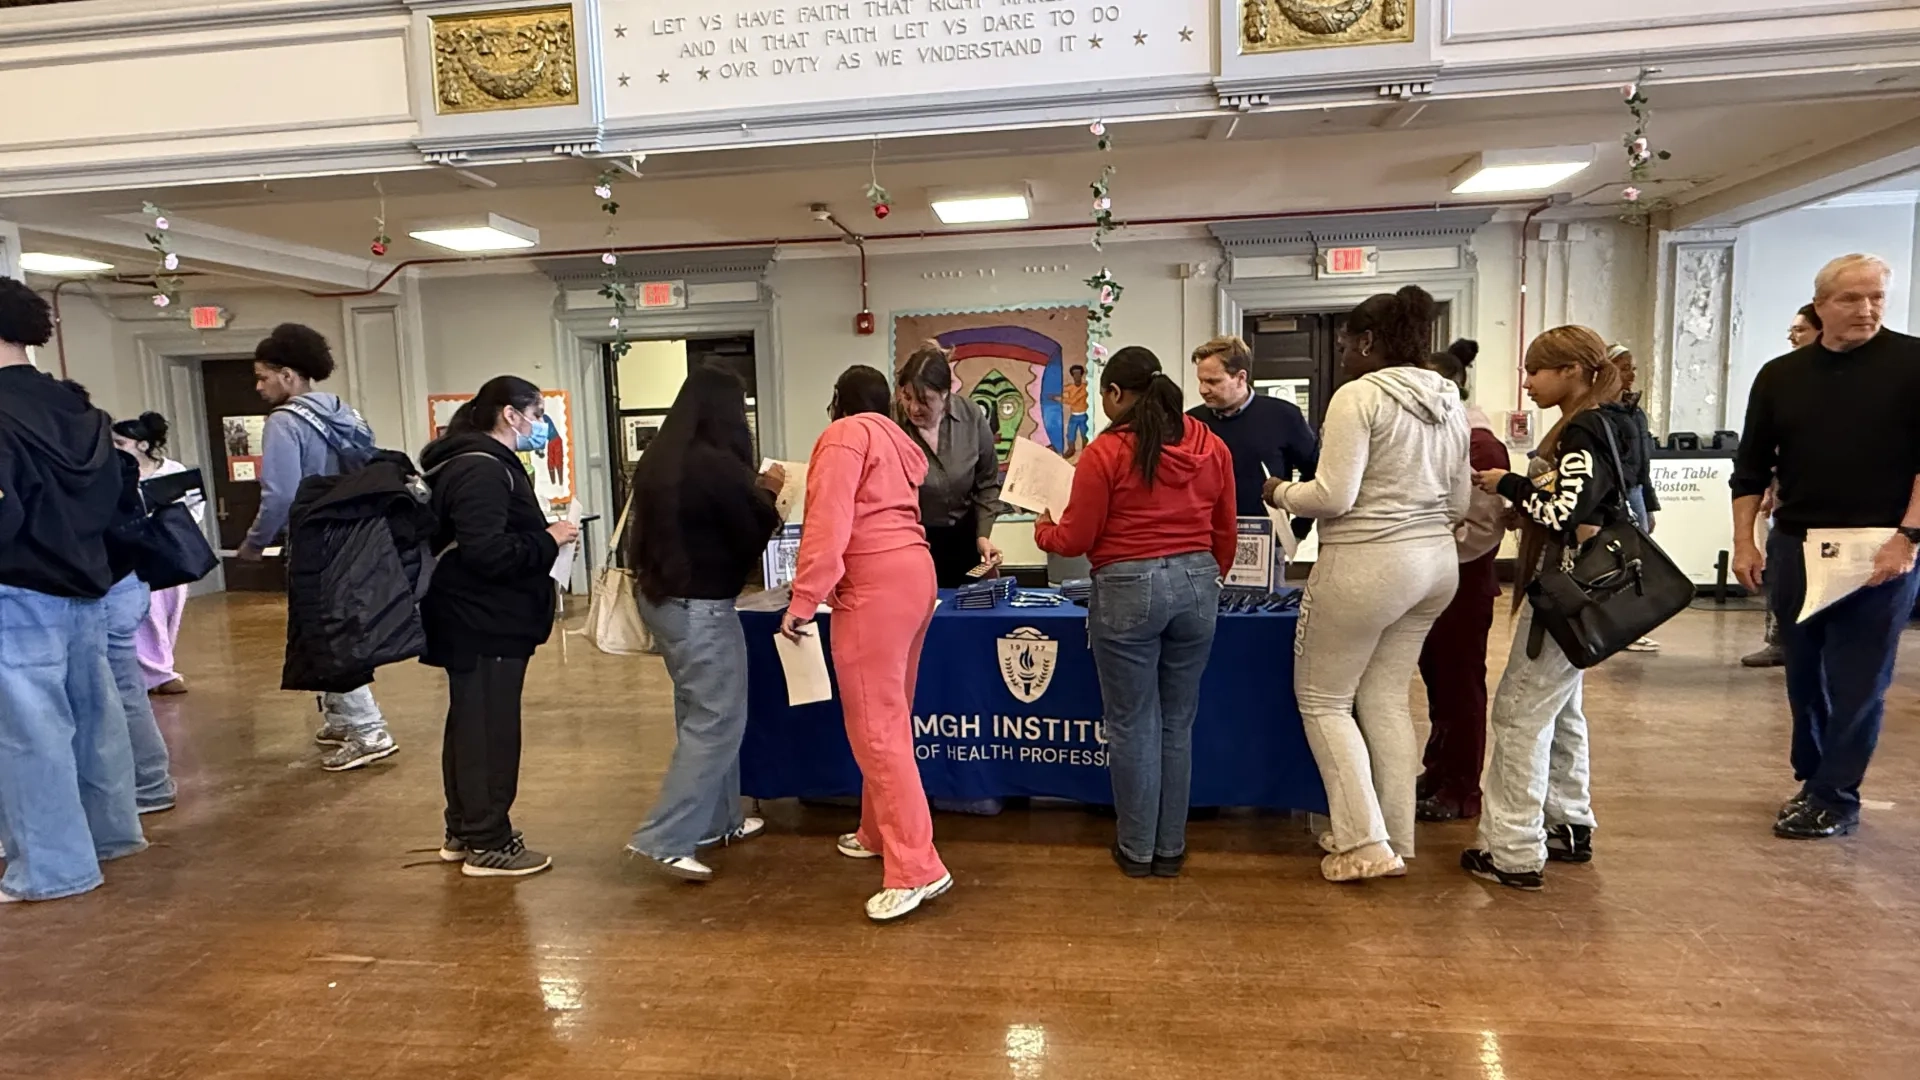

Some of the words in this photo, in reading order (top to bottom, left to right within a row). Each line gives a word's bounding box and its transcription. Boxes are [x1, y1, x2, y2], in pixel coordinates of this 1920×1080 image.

[652, 17, 686, 36] LET
[699, 14, 723, 31] VS
[736, 9, 785, 29] HAVE
[798, 3, 851, 24] FAITH
[864, 0, 912, 17] THAT
[679, 39, 717, 59] AND
[730, 36, 749, 54] IN
[761, 31, 810, 51] THAT
[825, 26, 878, 46] FAITH
[893, 21, 929, 41] LET
[943, 18, 967, 36] VS
[983, 12, 1035, 33] DARE
[1049, 9, 1075, 27] TO
[1092, 5, 1120, 24] DO
[719, 61, 759, 79] OVR
[772, 56, 821, 76] DVTY
[836, 52, 861, 70] AS
[876, 50, 903, 67] WE
[918, 38, 1042, 64] VNDERSTAND
[1059, 35, 1077, 53] IT
[1653, 466, 1679, 480] The
[1681, 466, 1719, 480] Table
[1654, 480, 1701, 492] Boston.
[913, 714, 980, 739] MGH
[993, 714, 1109, 744] INSTITU
[915, 744, 940, 760] OF
[947, 744, 1014, 761] HEALTH
